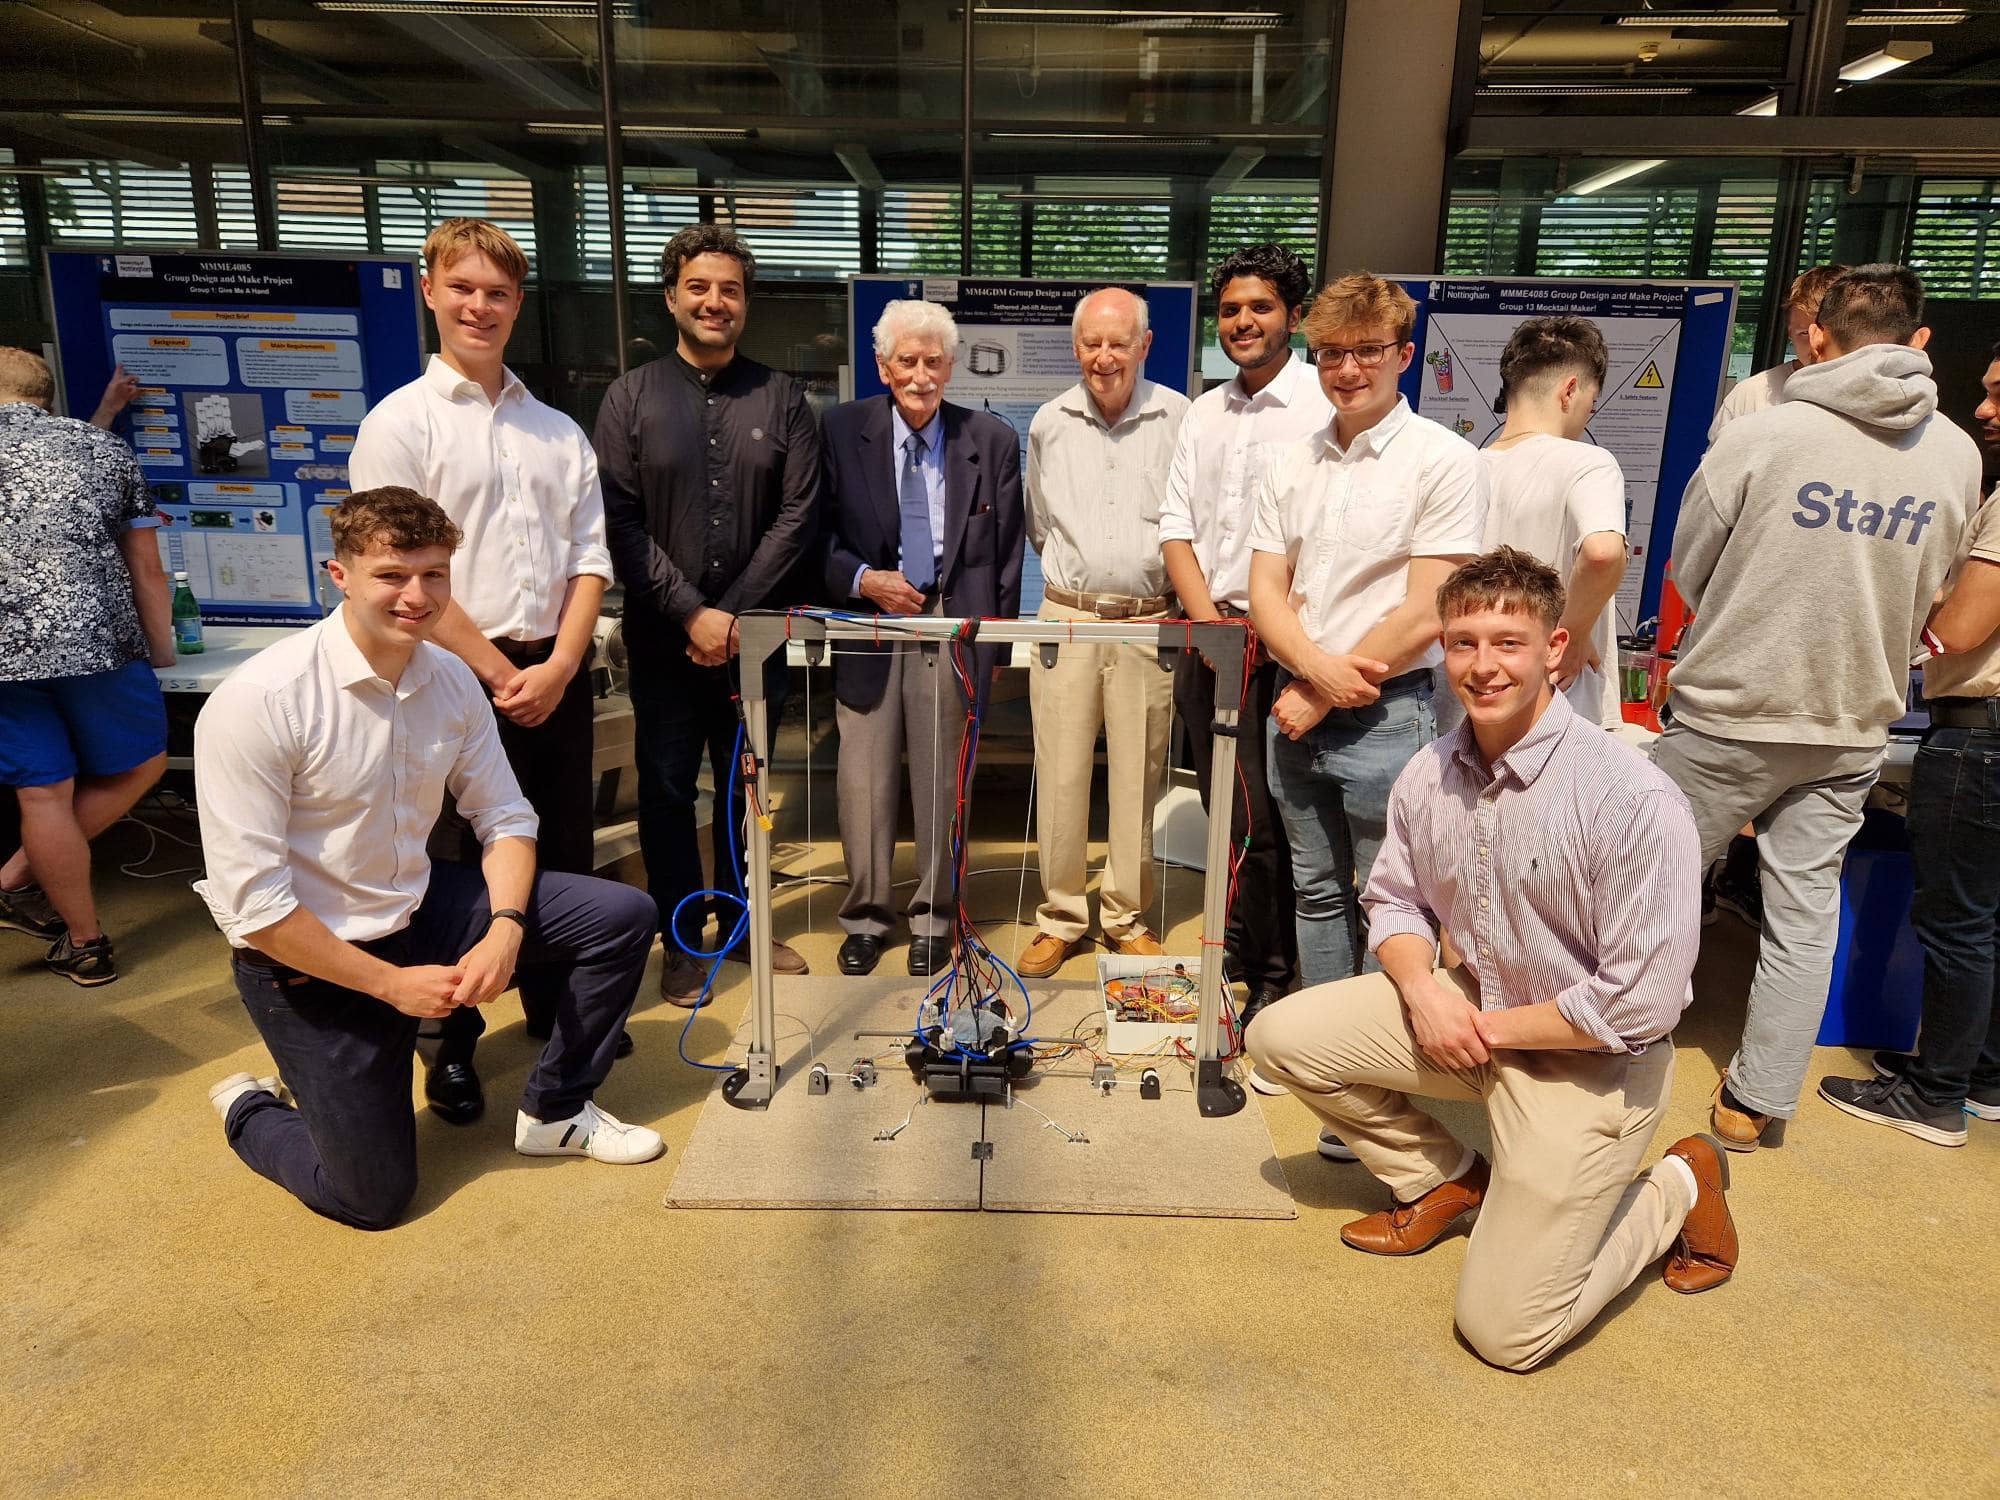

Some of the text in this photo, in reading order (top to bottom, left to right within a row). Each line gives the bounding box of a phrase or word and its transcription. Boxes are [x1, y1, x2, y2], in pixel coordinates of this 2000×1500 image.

[200, 262, 252, 272] MMME4085
[163, 273, 293, 286] Group Design and Make Project
[189, 286, 210, 295] Group
[965, 287, 1007, 296] MM4GDM
[1009, 288, 1033, 298] Group
[1035, 289, 1061, 299] Design
[1062, 289, 1077, 297] and
[1447, 291, 1490, 301] Nottingham
[1500, 289, 1683, 303] MMME4085 Group Design and Make Project
[993, 303, 1019, 311] Tethered
[1499, 303, 1597, 312] Group 13 Mocktail Maker!
[1792, 481, 1937, 546] Staff
